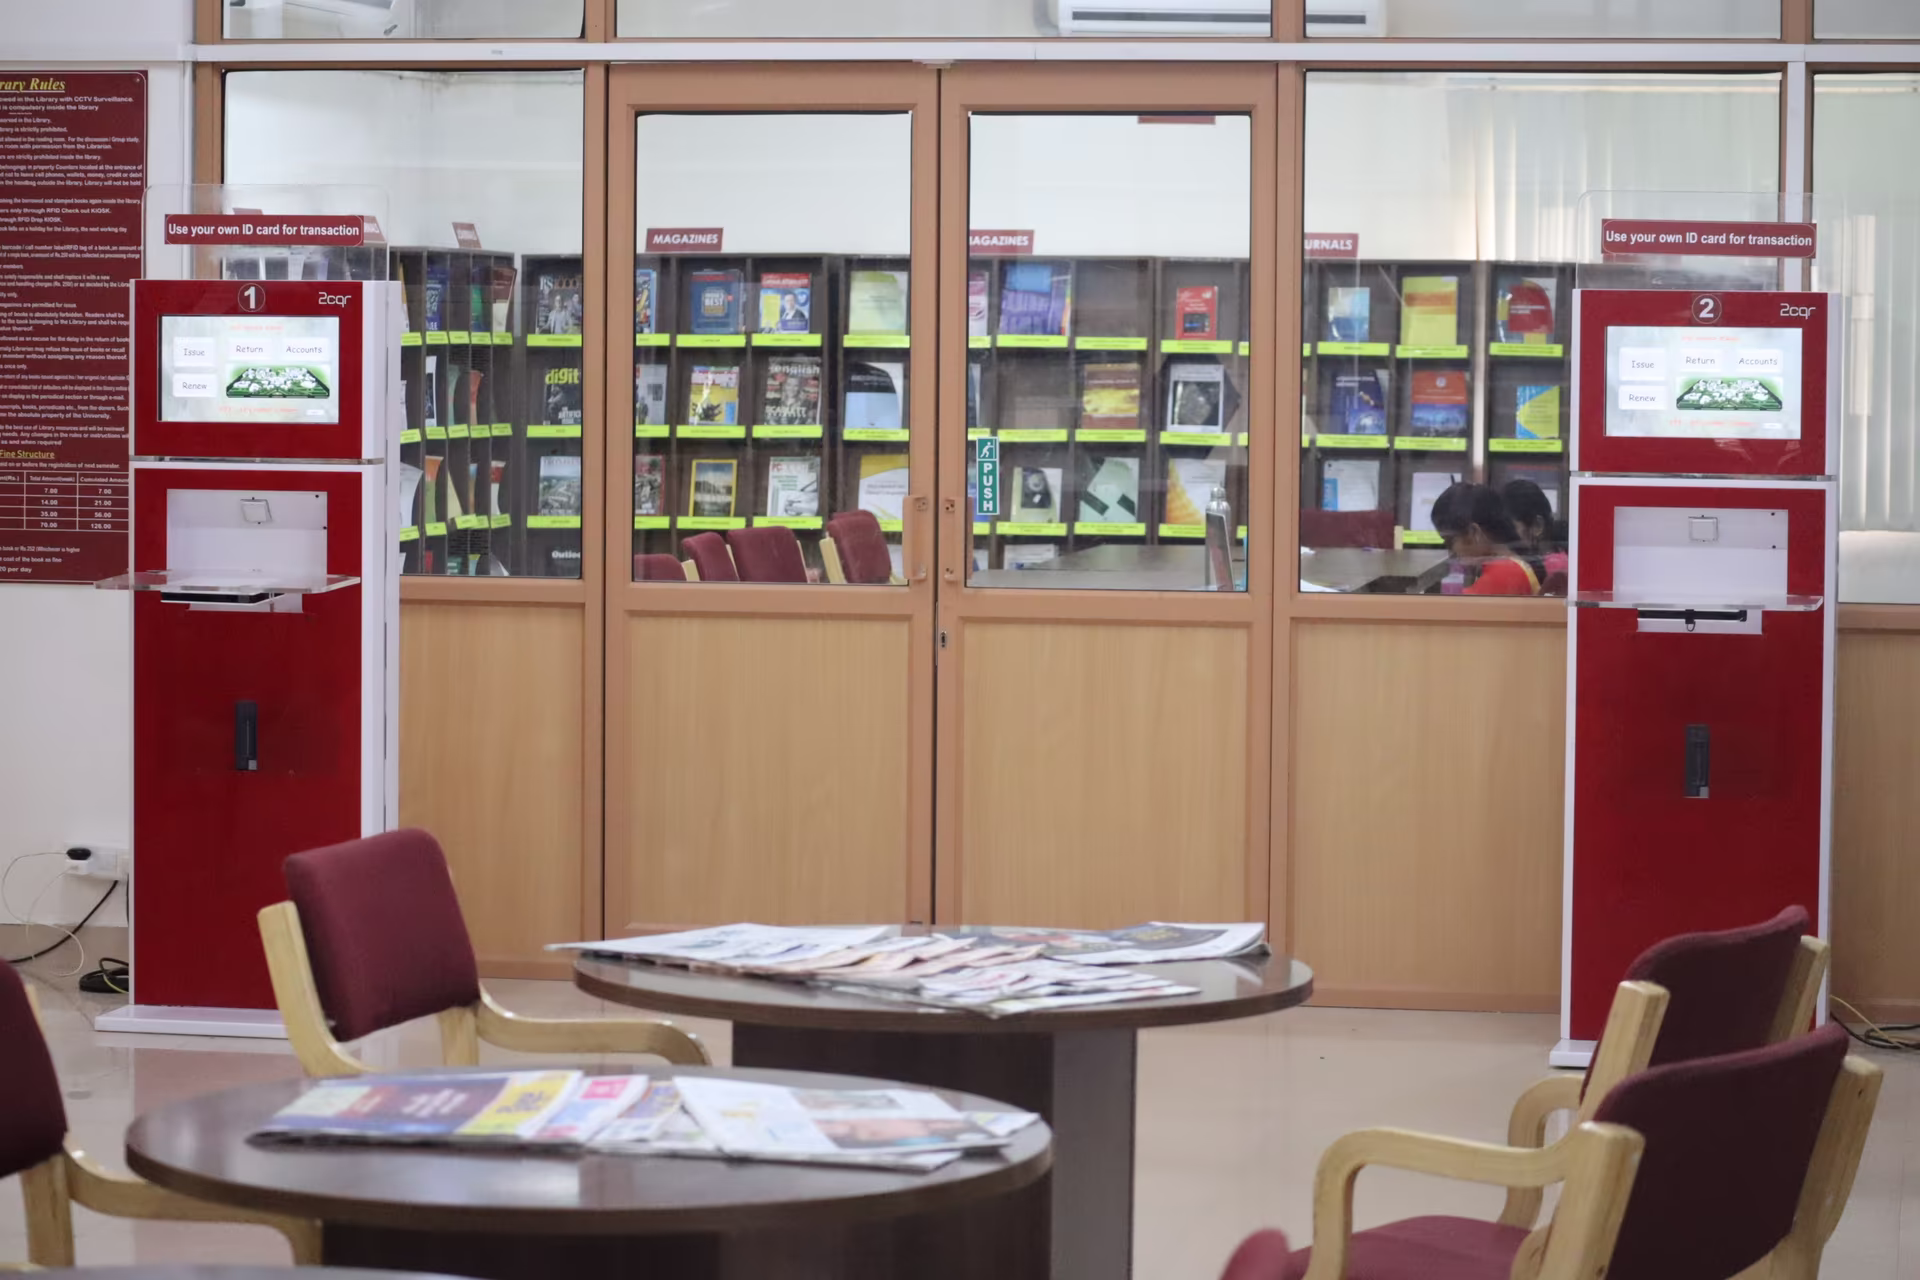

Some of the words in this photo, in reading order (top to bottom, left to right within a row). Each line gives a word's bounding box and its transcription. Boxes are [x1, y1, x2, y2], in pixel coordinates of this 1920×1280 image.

[30, 78, 66, 90] Rules
[168, 224, 188, 235] Use
[191, 226, 216, 238] your
[218, 226, 240, 235] own
[242, 224, 254, 235] ID
[256, 224, 281, 236] card
[282, 224, 298, 236] for
[300, 225, 360, 236] transaction
[652, 233, 719, 245] MAGAZINES
[1606, 231, 1627, 242] Use
[1630, 233, 1656, 245] your
[1659, 234, 1683, 244] own
[1686, 232, 1698, 244] ID
[1701, 232, 1727, 244] card
[1729, 232, 1746, 245] for
[1748, 234, 1812, 246] transaction
[244, 286, 256, 309] 1
[318, 292, 352, 307] 2cqr
[1699, 298, 1715, 318] 2
[1780, 303, 1816, 319] 2cqr
[184, 348, 205, 356] Issue
[236, 345, 263, 353] Return
[286, 345, 323, 354] Accounts
[1631, 360, 1655, 368] Issue
[1686, 356, 1715, 365] Return
[1738, 357, 1778, 365] Accounts
[545, 368, 579, 384] digit
[182, 382, 207, 390] Renew
[1628, 394, 1656, 402] Renew
[17, 449, 55, 459] Structure
[983, 463, 993, 511] PUSH
